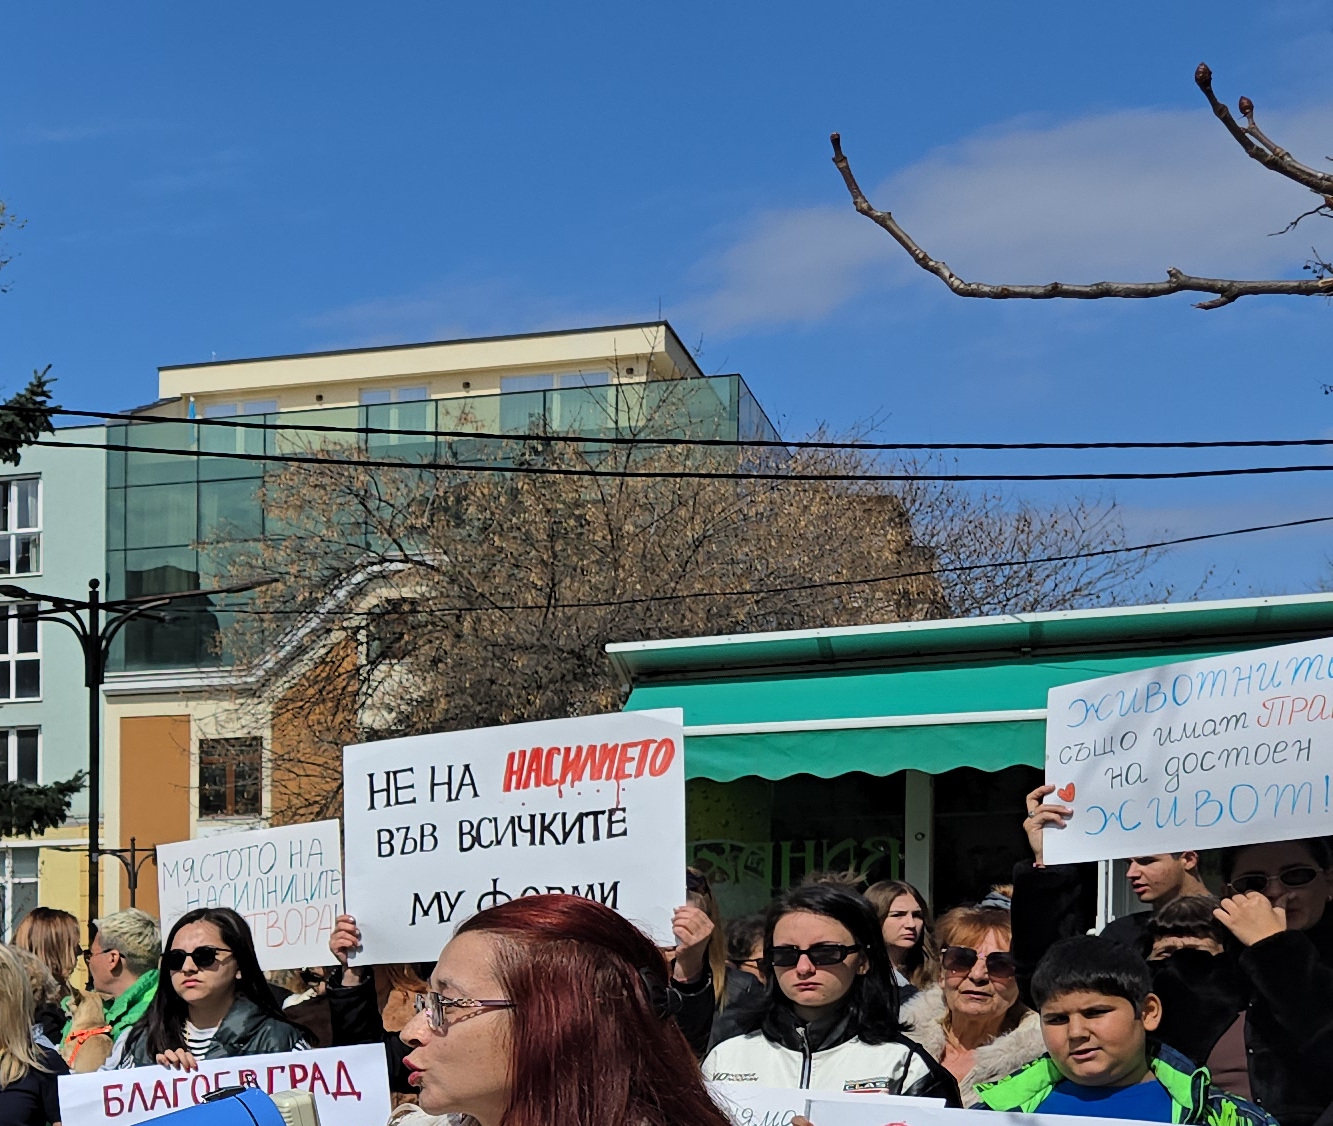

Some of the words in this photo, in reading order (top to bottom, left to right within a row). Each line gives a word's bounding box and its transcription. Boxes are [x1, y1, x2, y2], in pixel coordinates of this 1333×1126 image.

[1153, 712, 1249, 746] имат
[1257, 694, 1333, 727] ПРА
[366, 767, 417, 811] НЕ
[430, 763, 480, 803] НА
[502, 737, 676, 798] НАСИЛИЕТО
[1104, 762, 1148, 789] на
[1164, 738, 1312, 793] достоен
[376, 822, 438, 858] ВЪВ
[458, 807, 628, 853] ВСИЧКИТЕ
[162, 842, 277, 891] МЯСТОТО
[289, 838, 323, 869] НА
[408, 889, 466, 926] МУ
